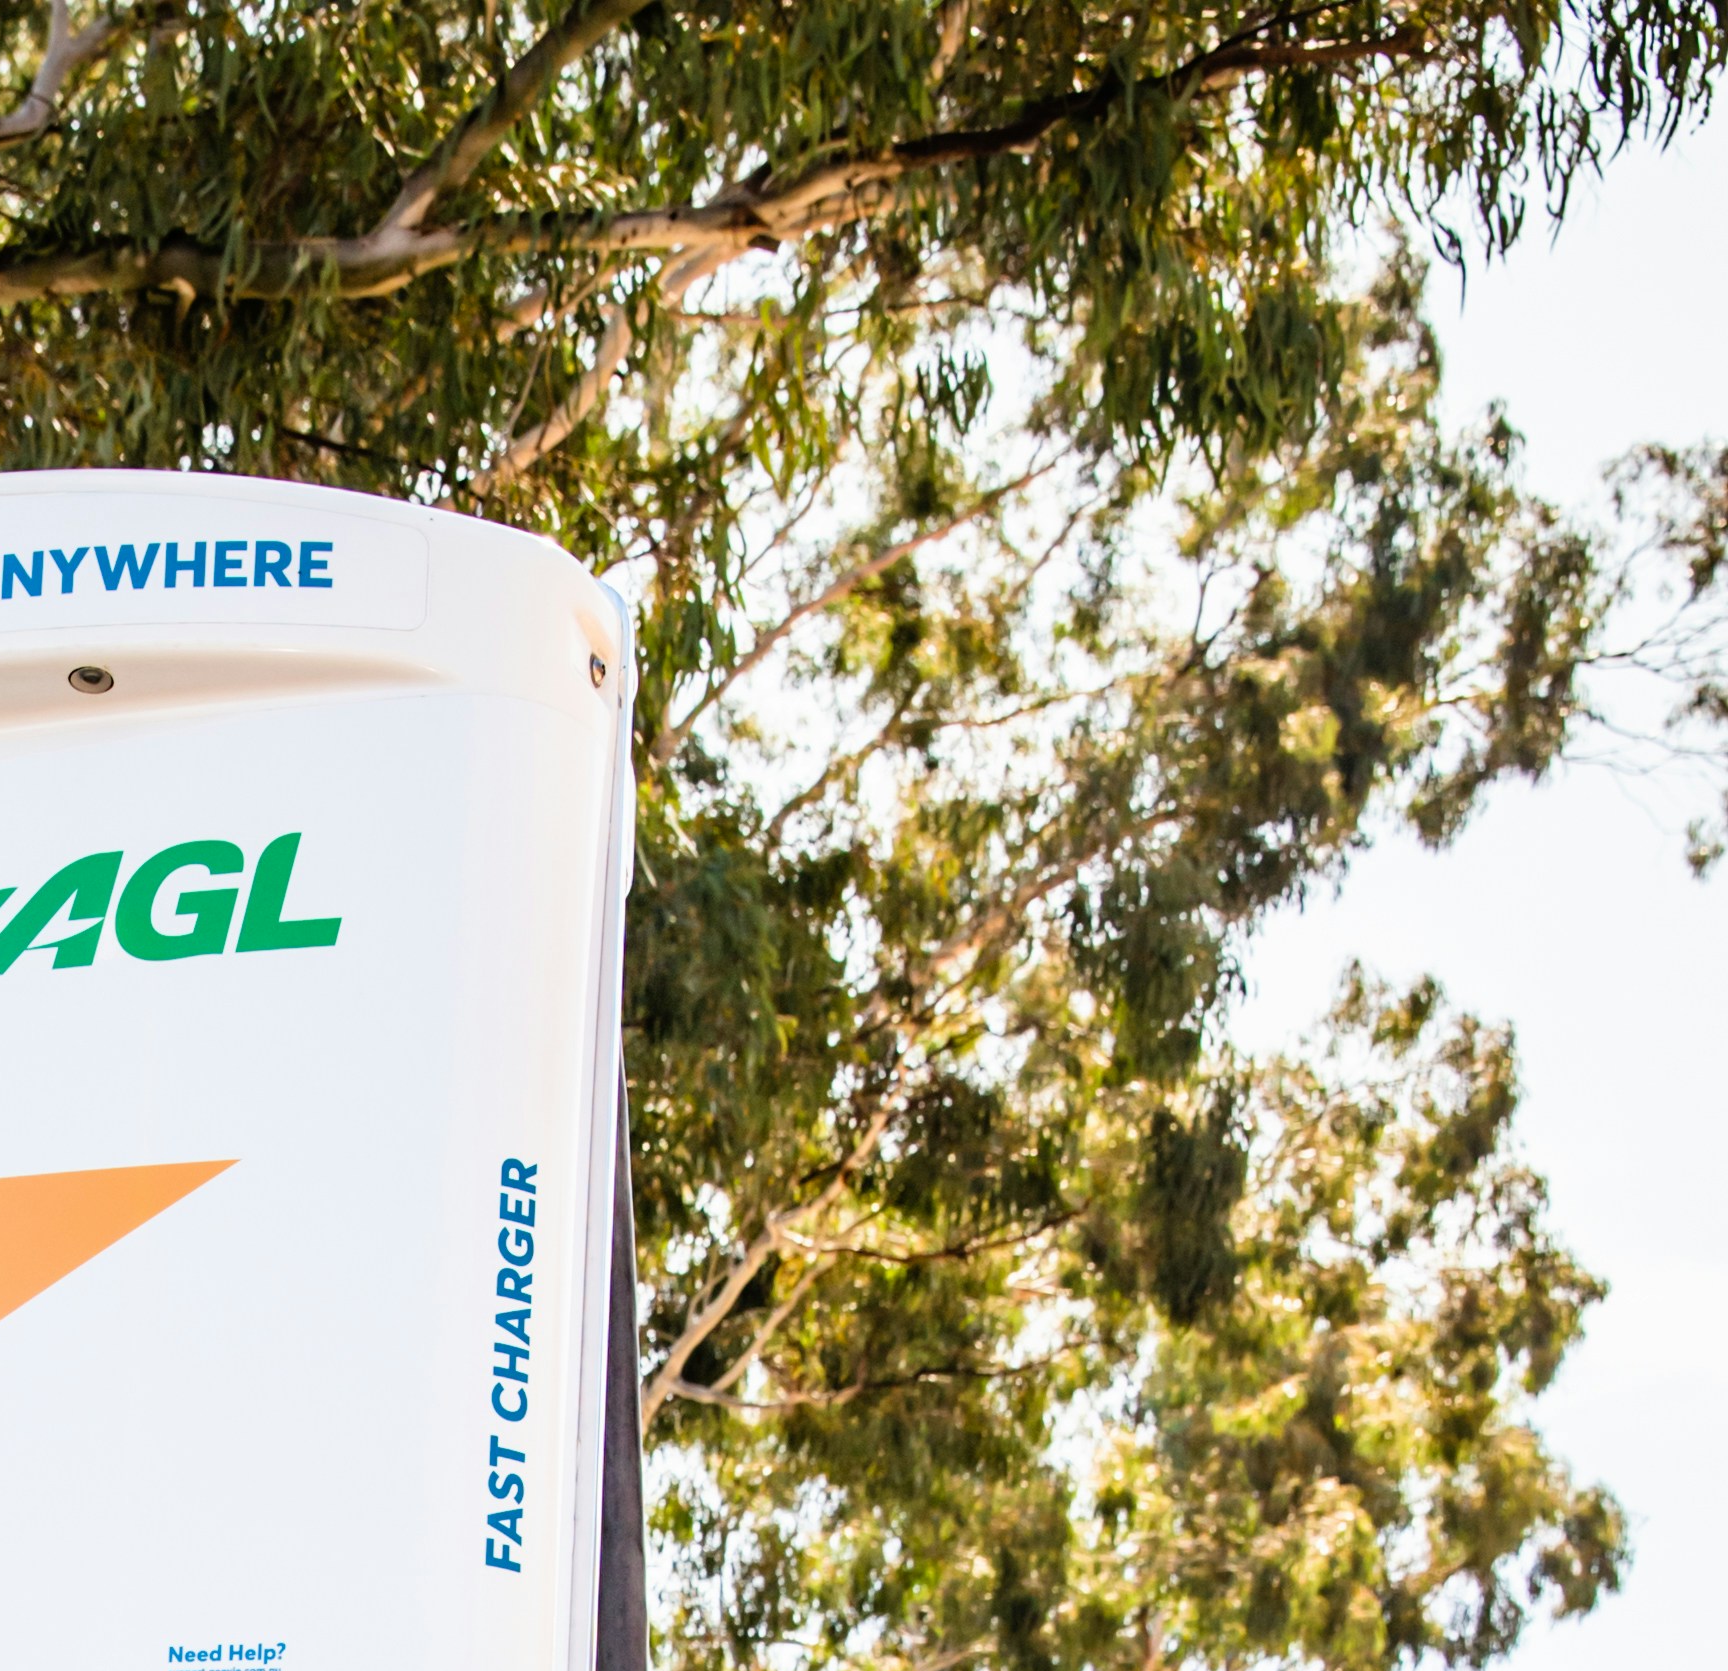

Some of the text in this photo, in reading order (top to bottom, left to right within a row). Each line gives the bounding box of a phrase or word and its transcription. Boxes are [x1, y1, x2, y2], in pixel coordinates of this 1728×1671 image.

[485, 1157, 539, 1574] FAST CHARGER
[168, 1642, 287, 1665] Need Help?
